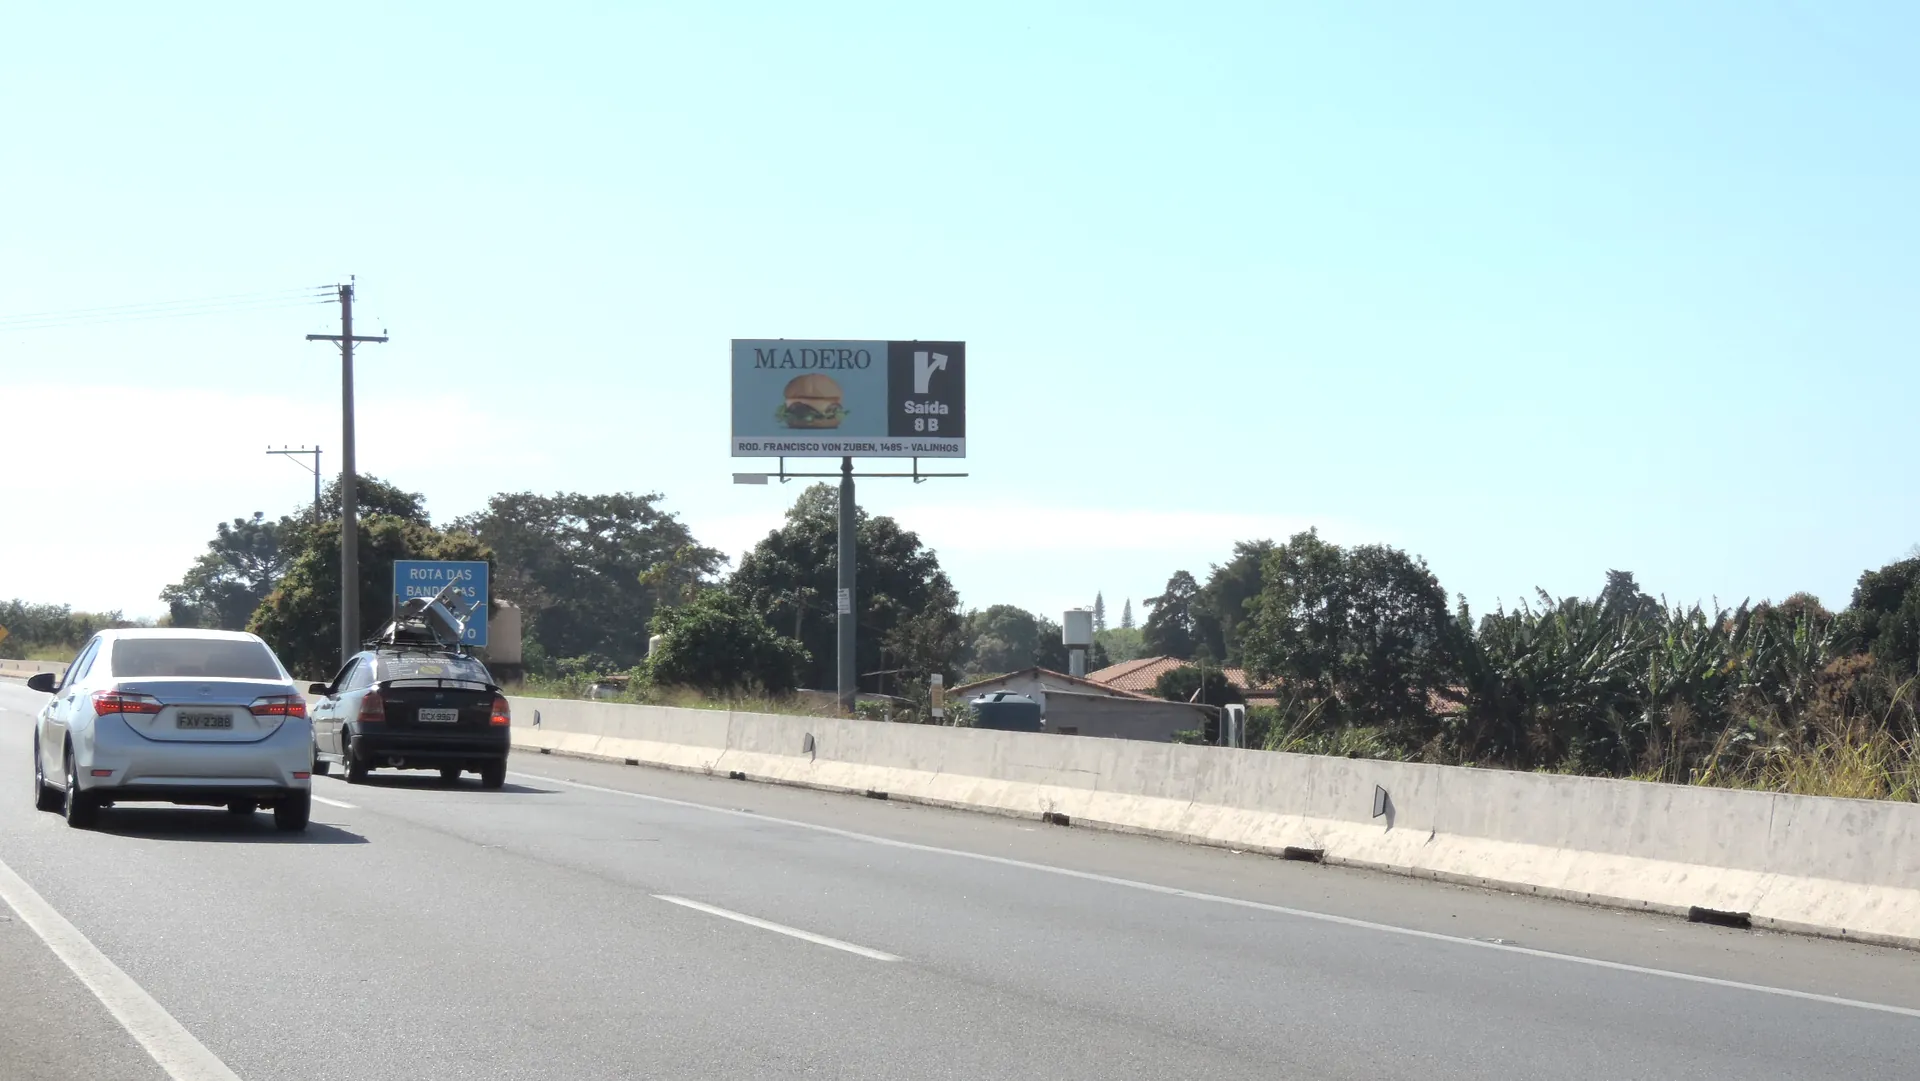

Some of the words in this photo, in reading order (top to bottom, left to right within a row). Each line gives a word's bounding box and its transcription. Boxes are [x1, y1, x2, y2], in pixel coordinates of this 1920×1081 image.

[754, 348, 871, 369] MADERO
[904, 400, 949, 415] Saída
[914, 418, 924, 432] 8
[928, 418, 939, 432] B
[738, 442, 761, 451] ROD.
[763, 442, 820, 452] FRANCISCO
[821, 442, 841, 452] VON
[843, 442, 878, 453] ZUBEN,
[880, 442, 902, 452] 1485
[911, 442, 959, 453] VALINHOS
[410, 568, 443, 580] ROTA
[446, 568, 472, 581] DAS
